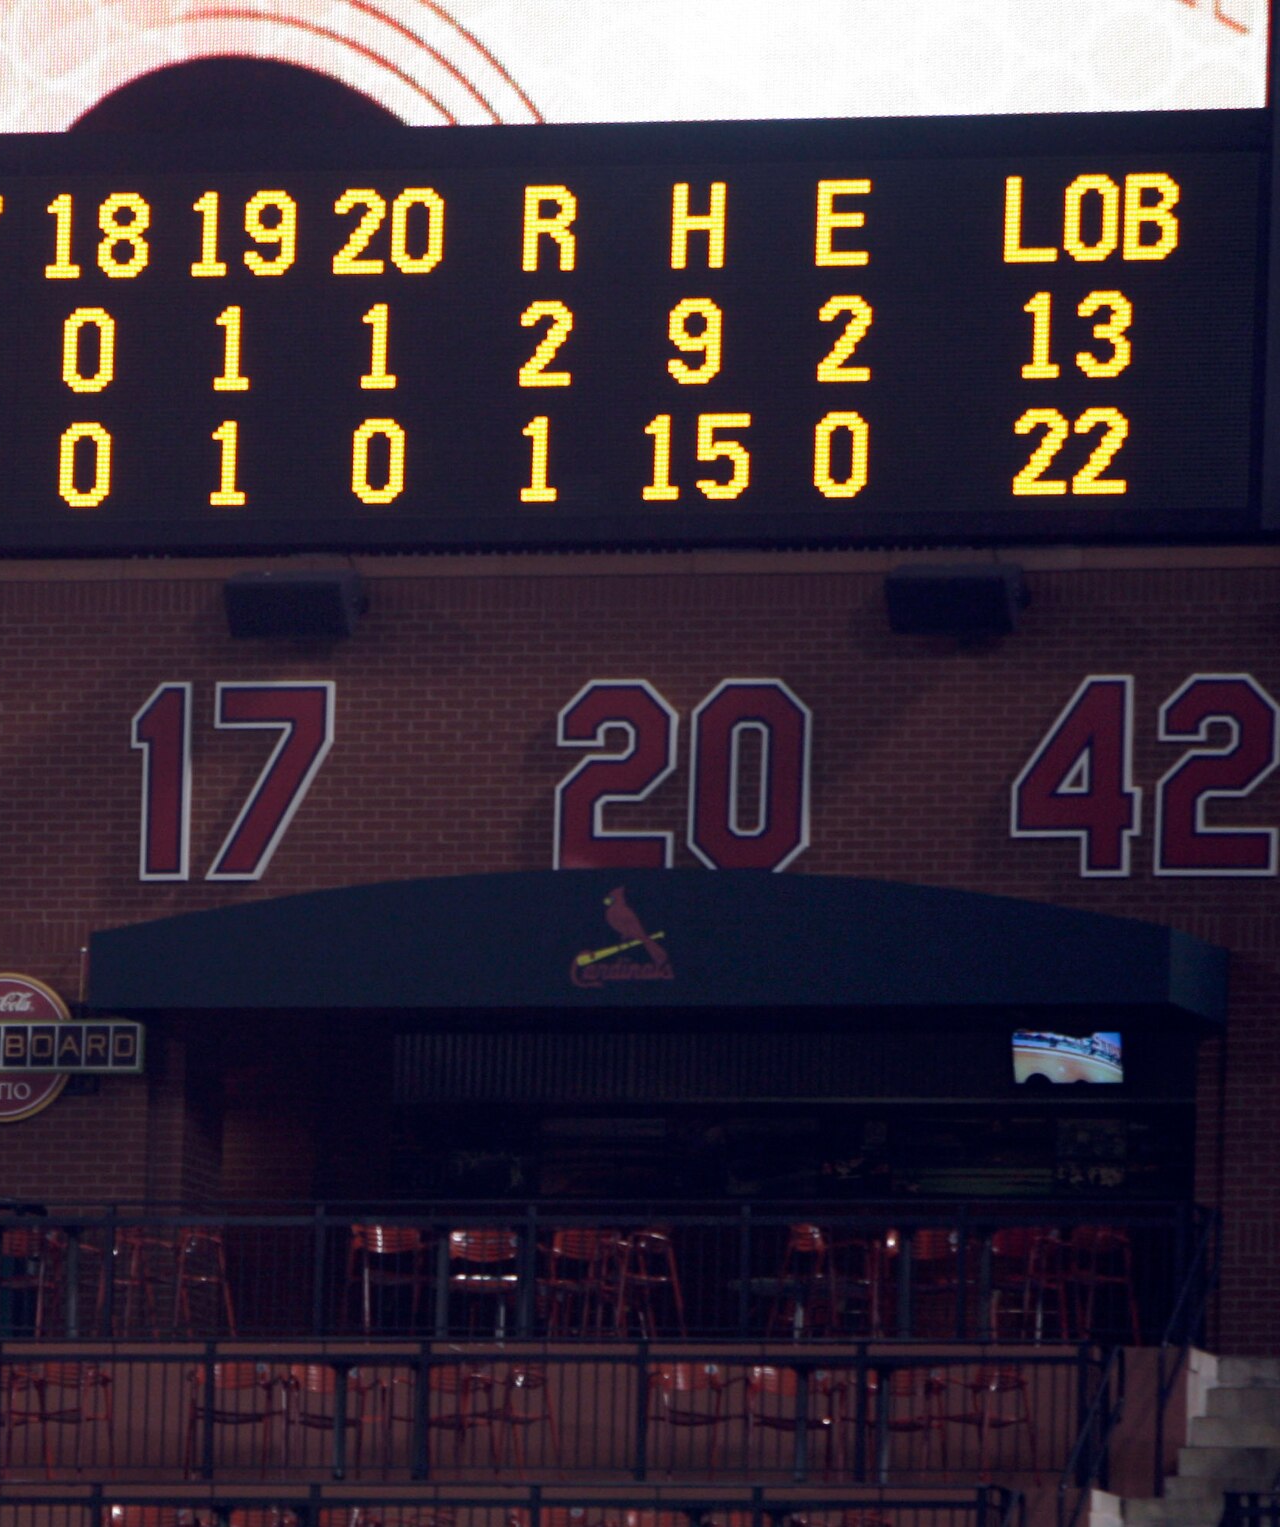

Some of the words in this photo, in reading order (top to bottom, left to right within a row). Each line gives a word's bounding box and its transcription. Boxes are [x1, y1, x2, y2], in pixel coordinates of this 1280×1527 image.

[45, 193, 149, 278] 18
[191, 191, 296, 276] 19
[333, 188, 444, 274] 20
[523, 186, 576, 271] R
[671, 183, 726, 269] H
[816, 180, 872, 266] E
[1004, 174, 1179, 262] LOB
[63, 308, 114, 392] 0
[214, 306, 248, 390] 1
[361, 304, 396, 389] 1
[519, 301, 572, 386] 2
[668, 298, 721, 384] 9
[817, 296, 872, 382] 2
[1022, 291, 1131, 378] 13
[59, 423, 111, 506] 0
[210, 421, 245, 505] 1
[352, 419, 405, 503] 0
[521, 417, 556, 502] 1
[643, 414, 750, 500] 15
[814, 412, 868, 497] 0
[1013, 408, 1128, 495] 22
[131, 681, 336, 881] 17
[553, 679, 812, 873] 20
[1011, 674, 1280, 877] 42
